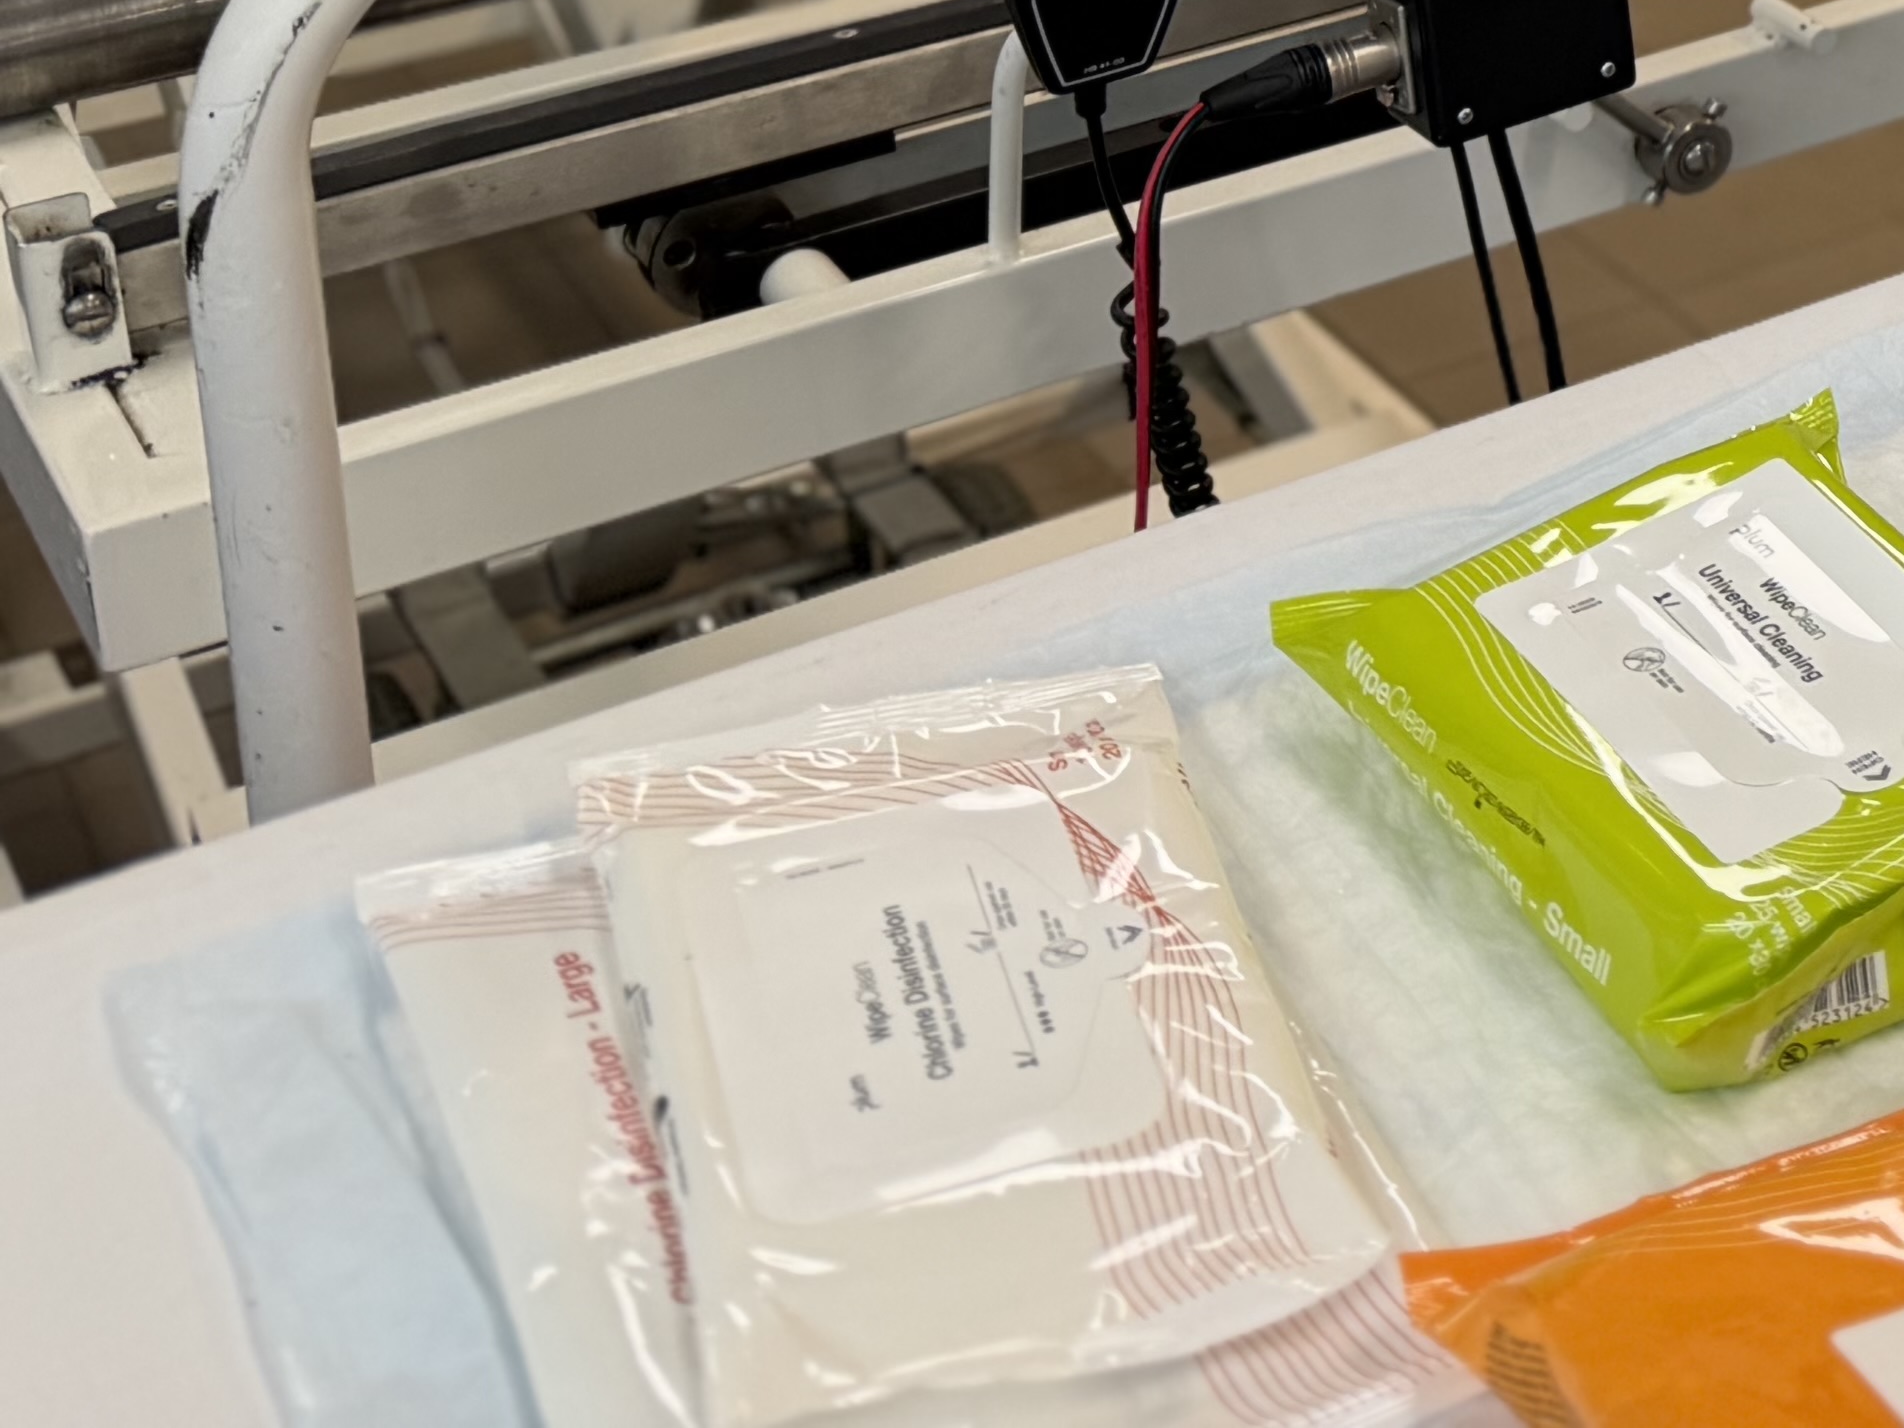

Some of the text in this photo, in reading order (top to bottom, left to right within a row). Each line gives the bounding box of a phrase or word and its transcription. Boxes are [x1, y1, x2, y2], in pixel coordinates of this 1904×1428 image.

[1729, 523, 1776, 560] plum
[1698, 563, 1763, 625] Universal
[1758, 623, 1824, 684] Cleaning
[1758, 577, 1827, 641] WipeClean
[1344, 639, 1438, 755] WipeClean
[554, 951, 602, 1020] Large
[1543, 902, 1612, 987] Small
[882, 904, 954, 1081] Chlorine Disinfection
